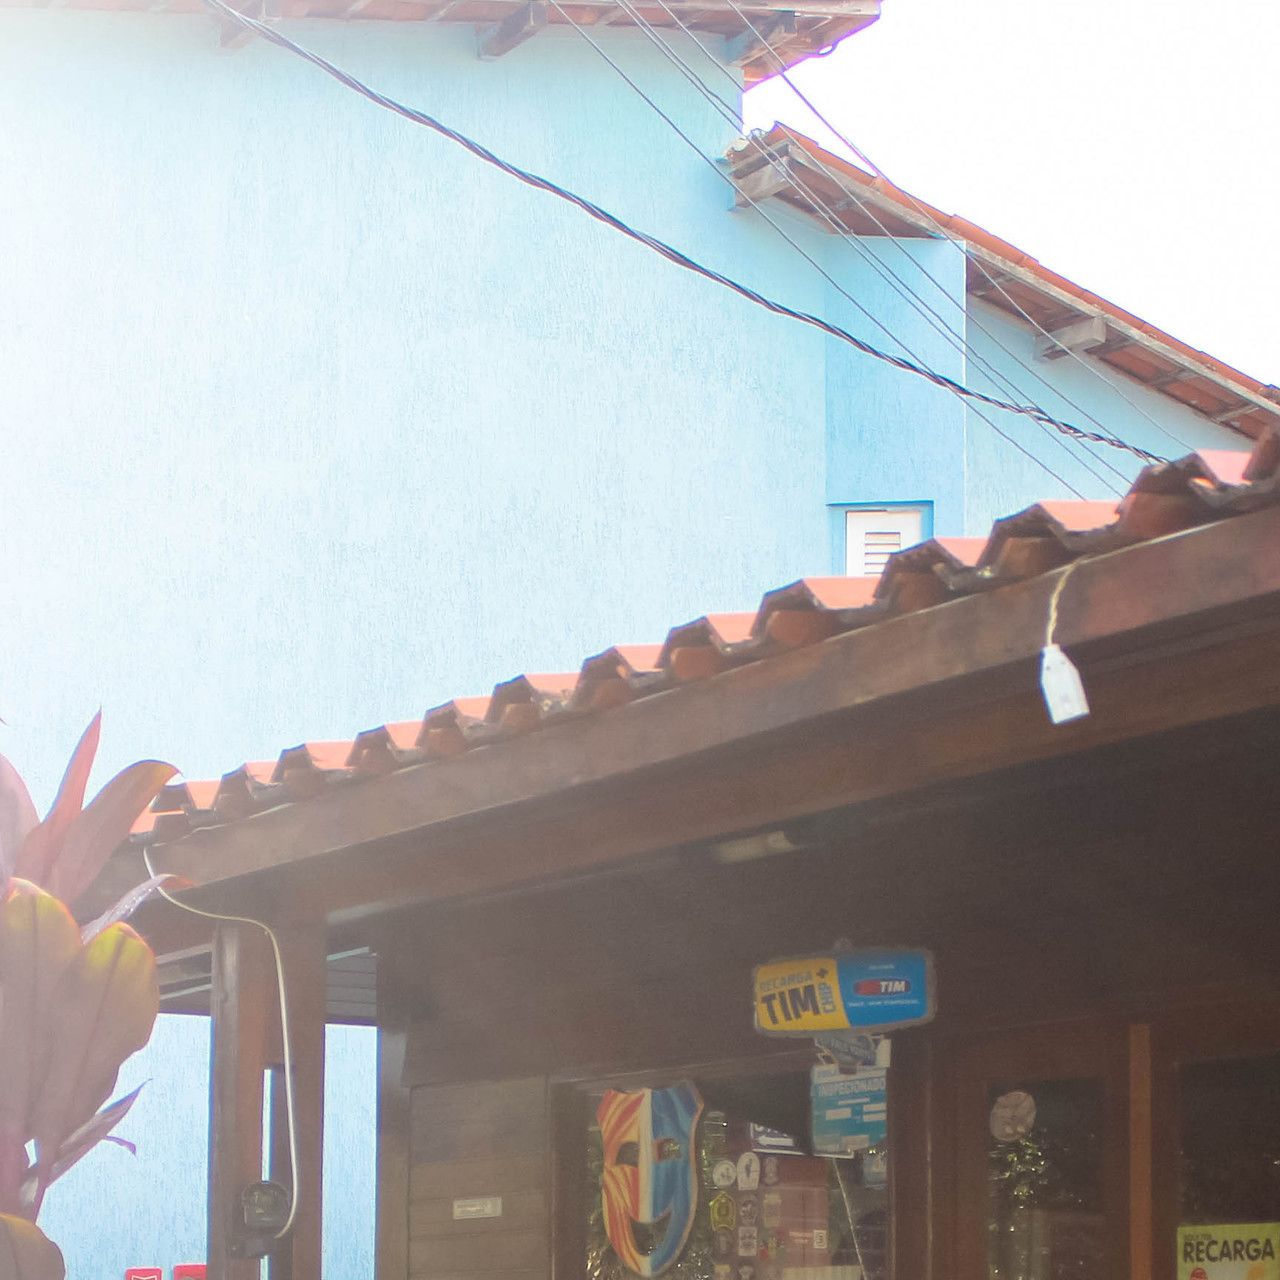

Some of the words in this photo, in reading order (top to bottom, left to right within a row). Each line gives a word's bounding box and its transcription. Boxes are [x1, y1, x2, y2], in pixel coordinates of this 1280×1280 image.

[880, 980, 907, 993] TIM
[761, 984, 820, 1025] TIM
[1183, 1238, 1276, 1263] RECARGA
